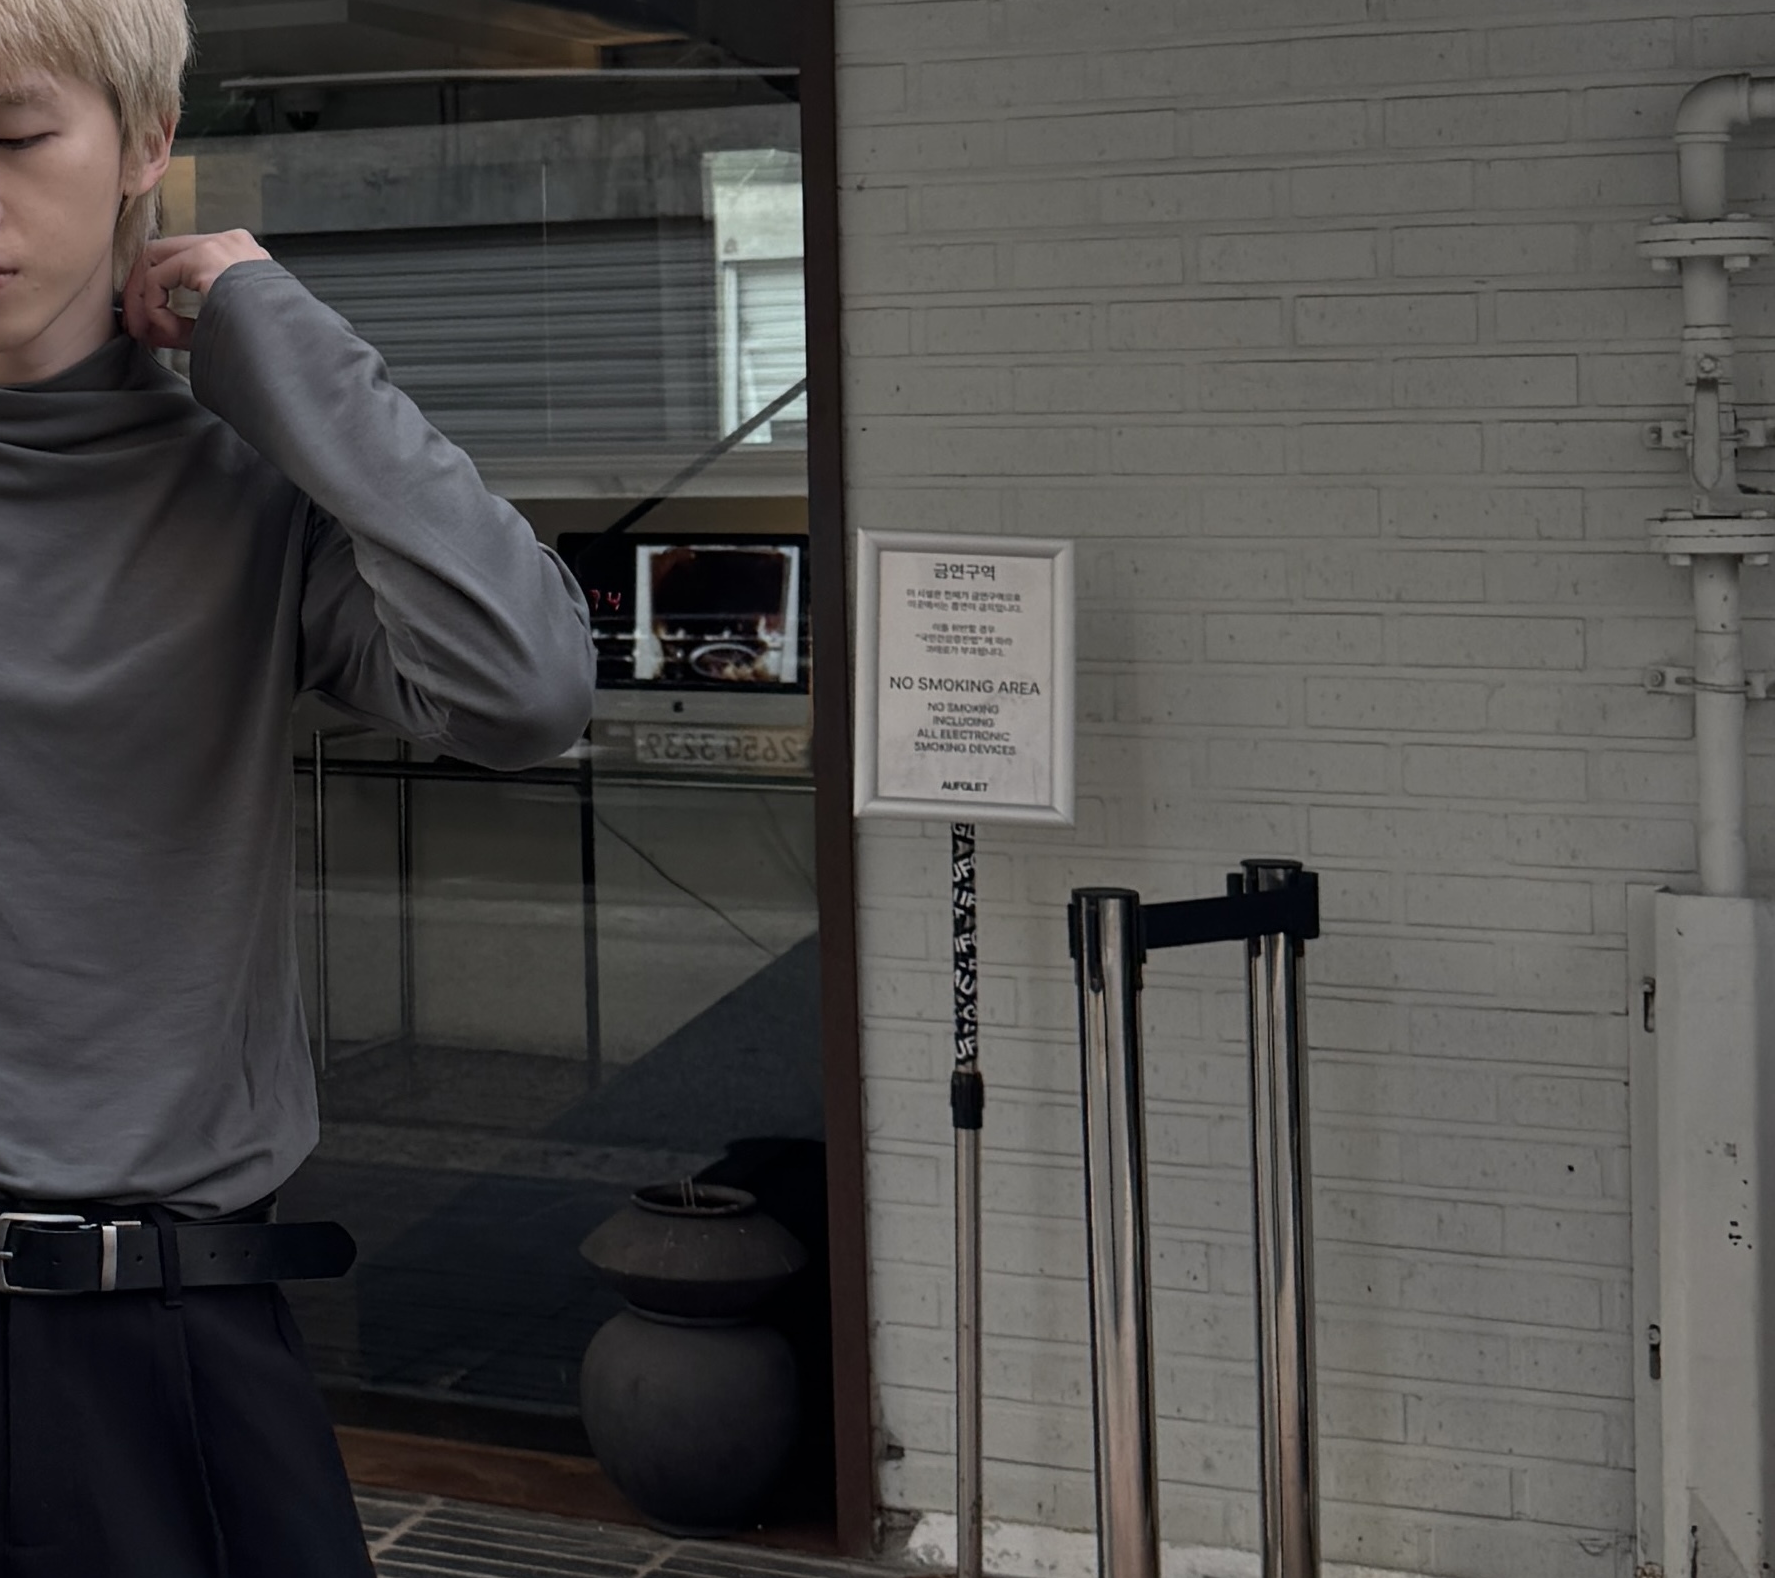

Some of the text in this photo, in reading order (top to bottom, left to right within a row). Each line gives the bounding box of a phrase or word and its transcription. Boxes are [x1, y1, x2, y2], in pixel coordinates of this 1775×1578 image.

[933, 563, 996, 581] 금연구역
[890, 676, 1041, 695] NO SMOKING AREA
[927, 702, 1000, 715] NO SMOKING
[933, 716, 995, 727] INCLUDING
[917, 728, 1011, 741] ALL ELECTRONIC
[914, 741, 1017, 756] SMOKING DEVICES
